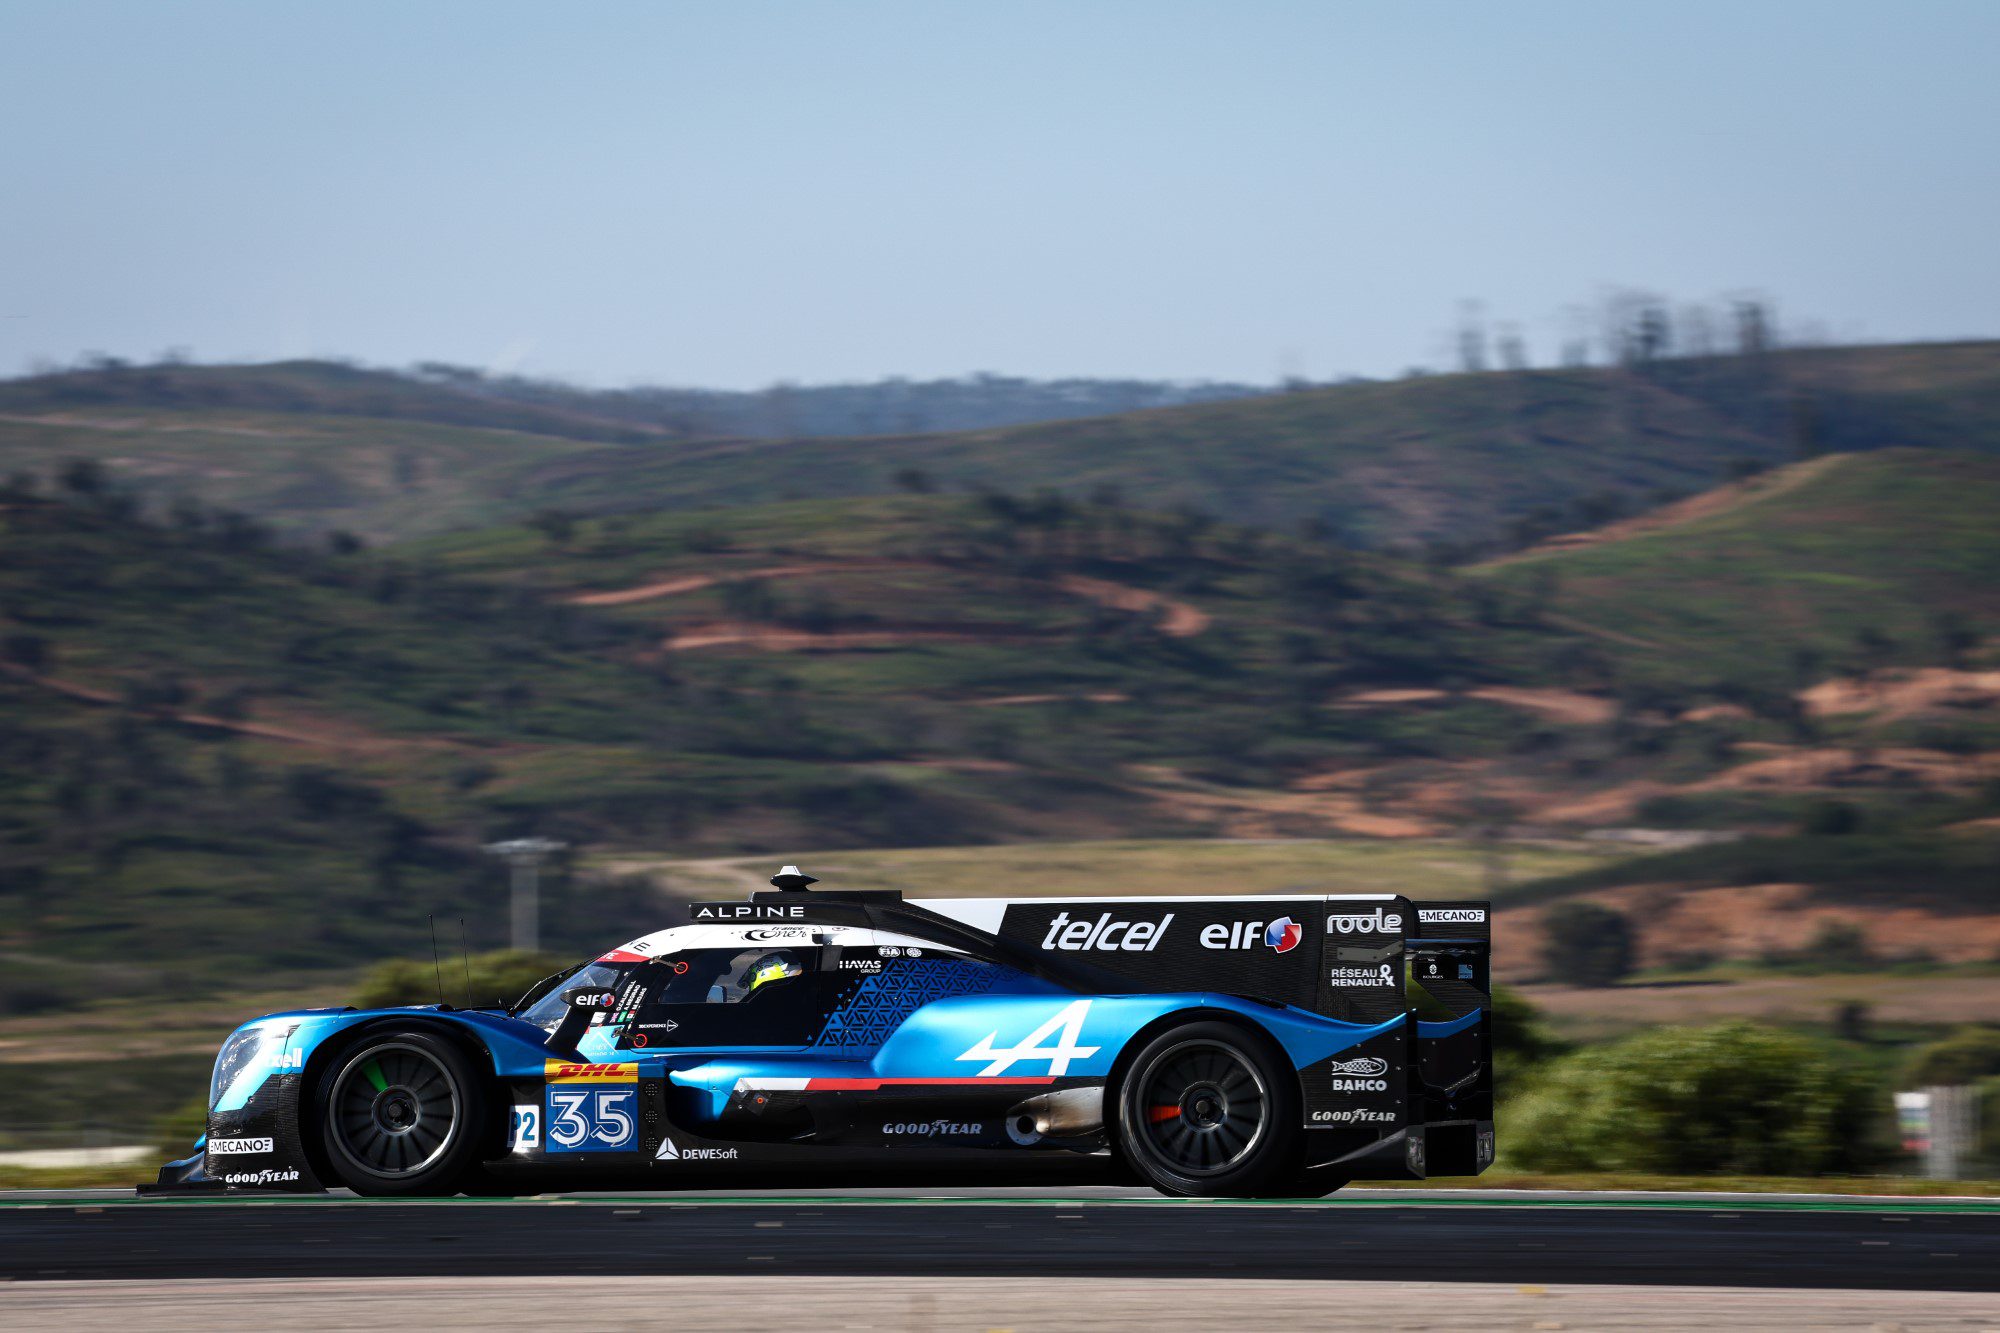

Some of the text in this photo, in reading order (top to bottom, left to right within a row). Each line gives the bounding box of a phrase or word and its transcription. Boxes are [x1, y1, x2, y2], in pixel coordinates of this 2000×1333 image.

[696, 906, 804, 918] ALPINE
[1326, 907, 1402, 934] roole
[1041, 912, 1175, 951] telcel
[1199, 921, 1263, 950] elf
[839, 960, 881, 969] HAVAS
[1331, 966, 1378, 978] RÉSEAU
[1331, 978, 1385, 987] RENAULT
[575, 994, 600, 1006] elf
[556, 1064, 626, 1077] DHL
[1333, 1080, 1388, 1091] BAHCO
[550, 1091, 634, 1148] 35
[1312, 1108, 1396, 1125] GOODYEAR
[882, 1120, 982, 1138] GOODYEAR
[683, 1149, 738, 1160] DEWESoft
[225, 1169, 299, 1185] GOODYEAR
